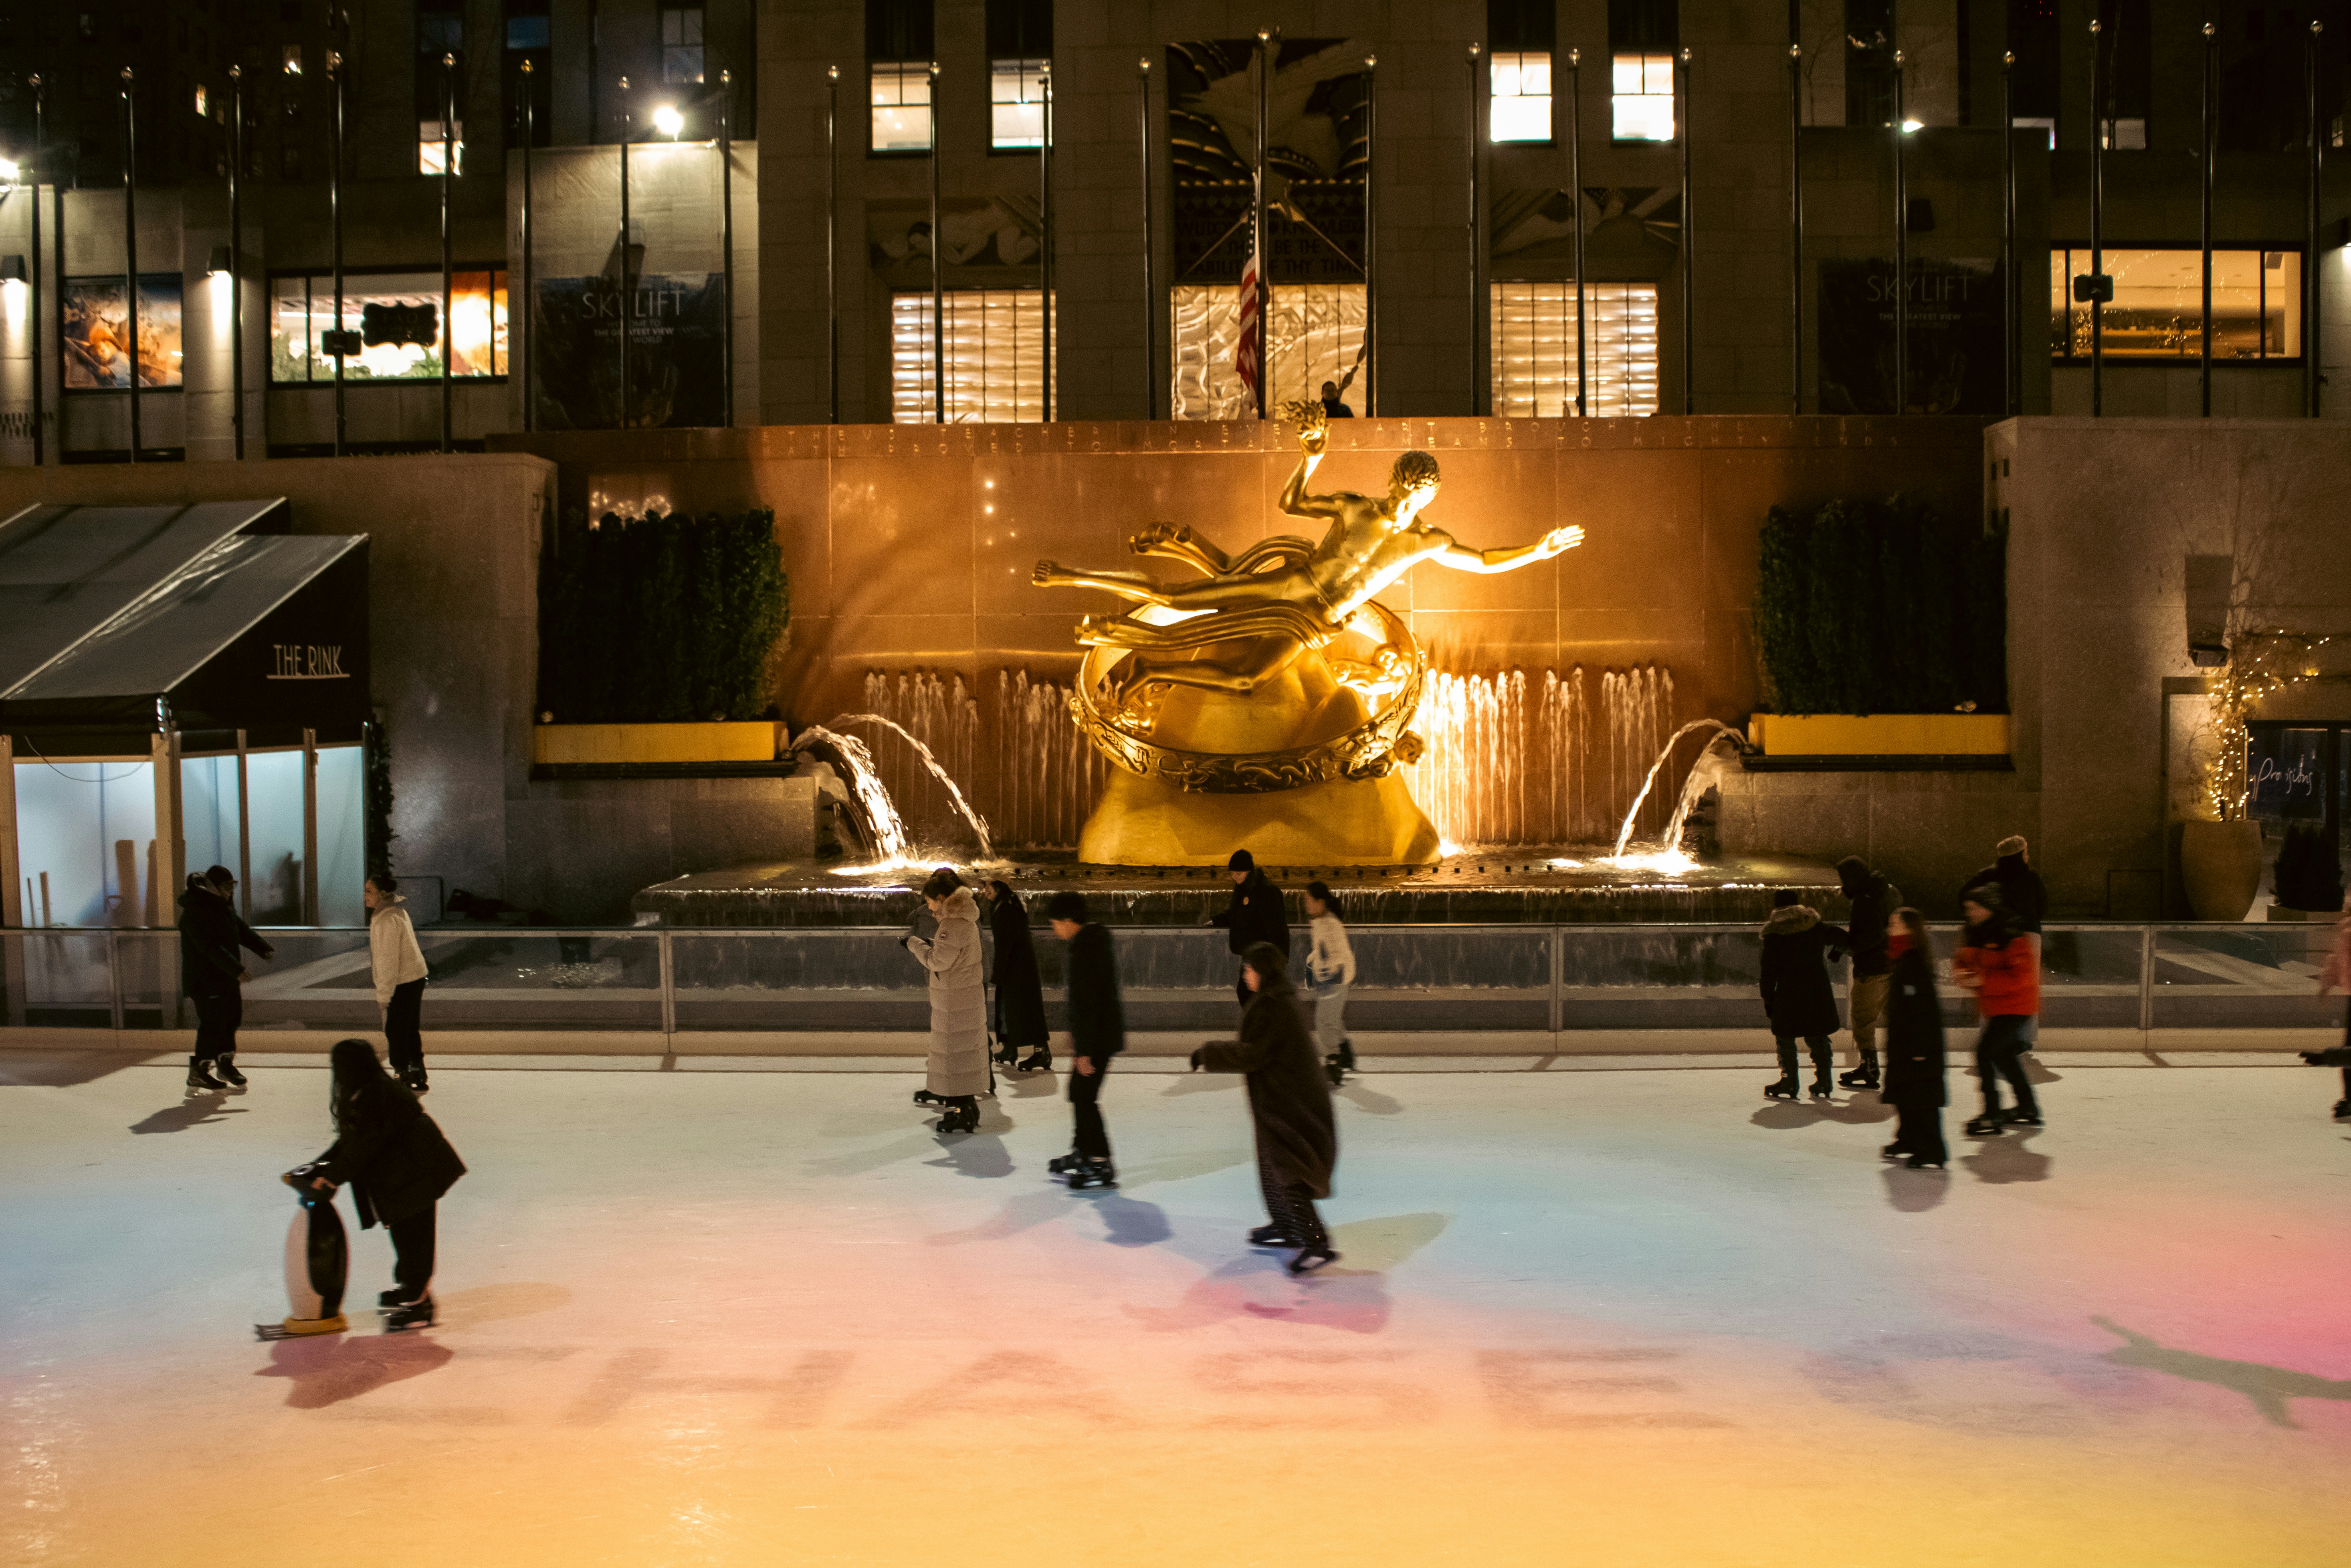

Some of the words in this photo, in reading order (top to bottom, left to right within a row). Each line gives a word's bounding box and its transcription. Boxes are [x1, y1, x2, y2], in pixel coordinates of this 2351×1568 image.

[1283, 259, 1314, 274] THY
[581, 290, 685, 319] SKLIFT
[1939, 313, 1962, 321] VIEW
[594, 328, 608, 337] THE
[652, 327, 674, 335] VIEW
[273, 644, 302, 676] THE
[308, 645, 342, 676] RINK
